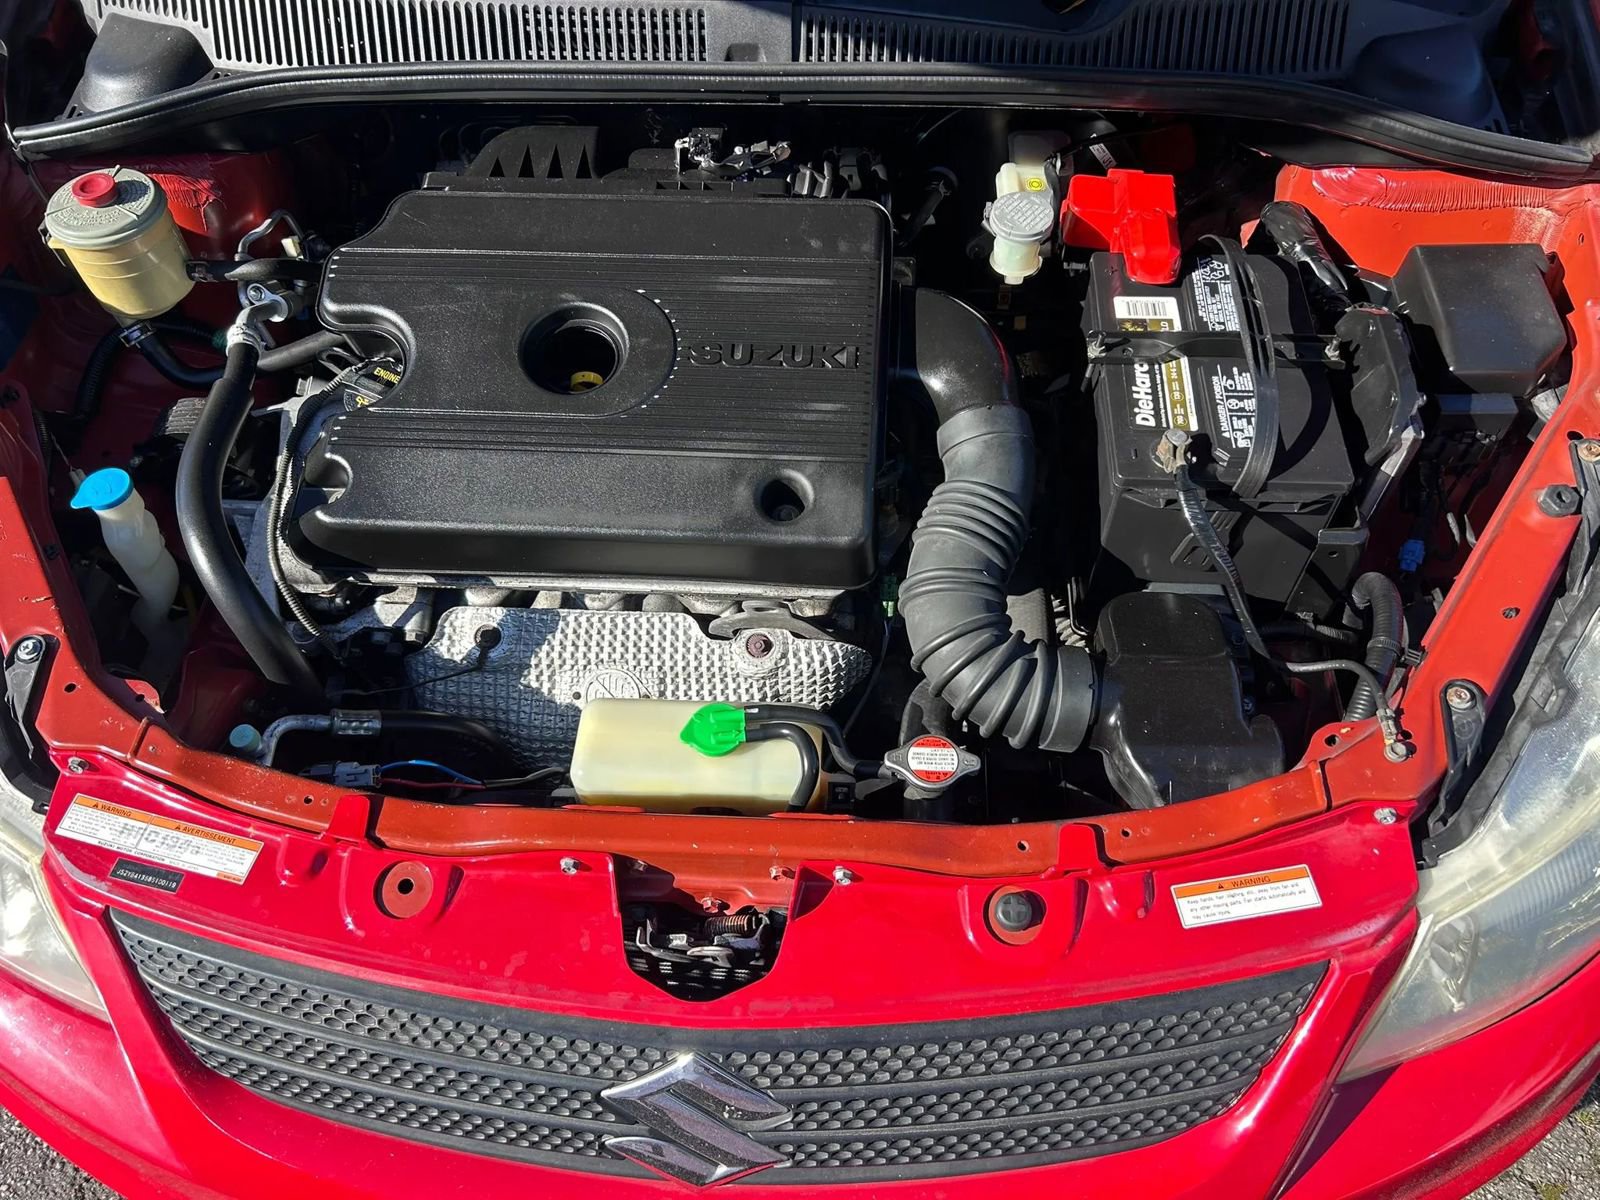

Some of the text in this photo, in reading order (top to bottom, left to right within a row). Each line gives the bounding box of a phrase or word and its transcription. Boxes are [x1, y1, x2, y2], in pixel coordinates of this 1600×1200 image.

[688, 342, 859, 369] SUZUKI
[1211, 375, 1223, 399] POISON
[1217, 404, 1229, 431] DANGER
[100, 803, 132, 817] WARNING
[182, 826, 237, 845] AVERTISSEMENT
[1231, 875, 1271, 888] WARNING
